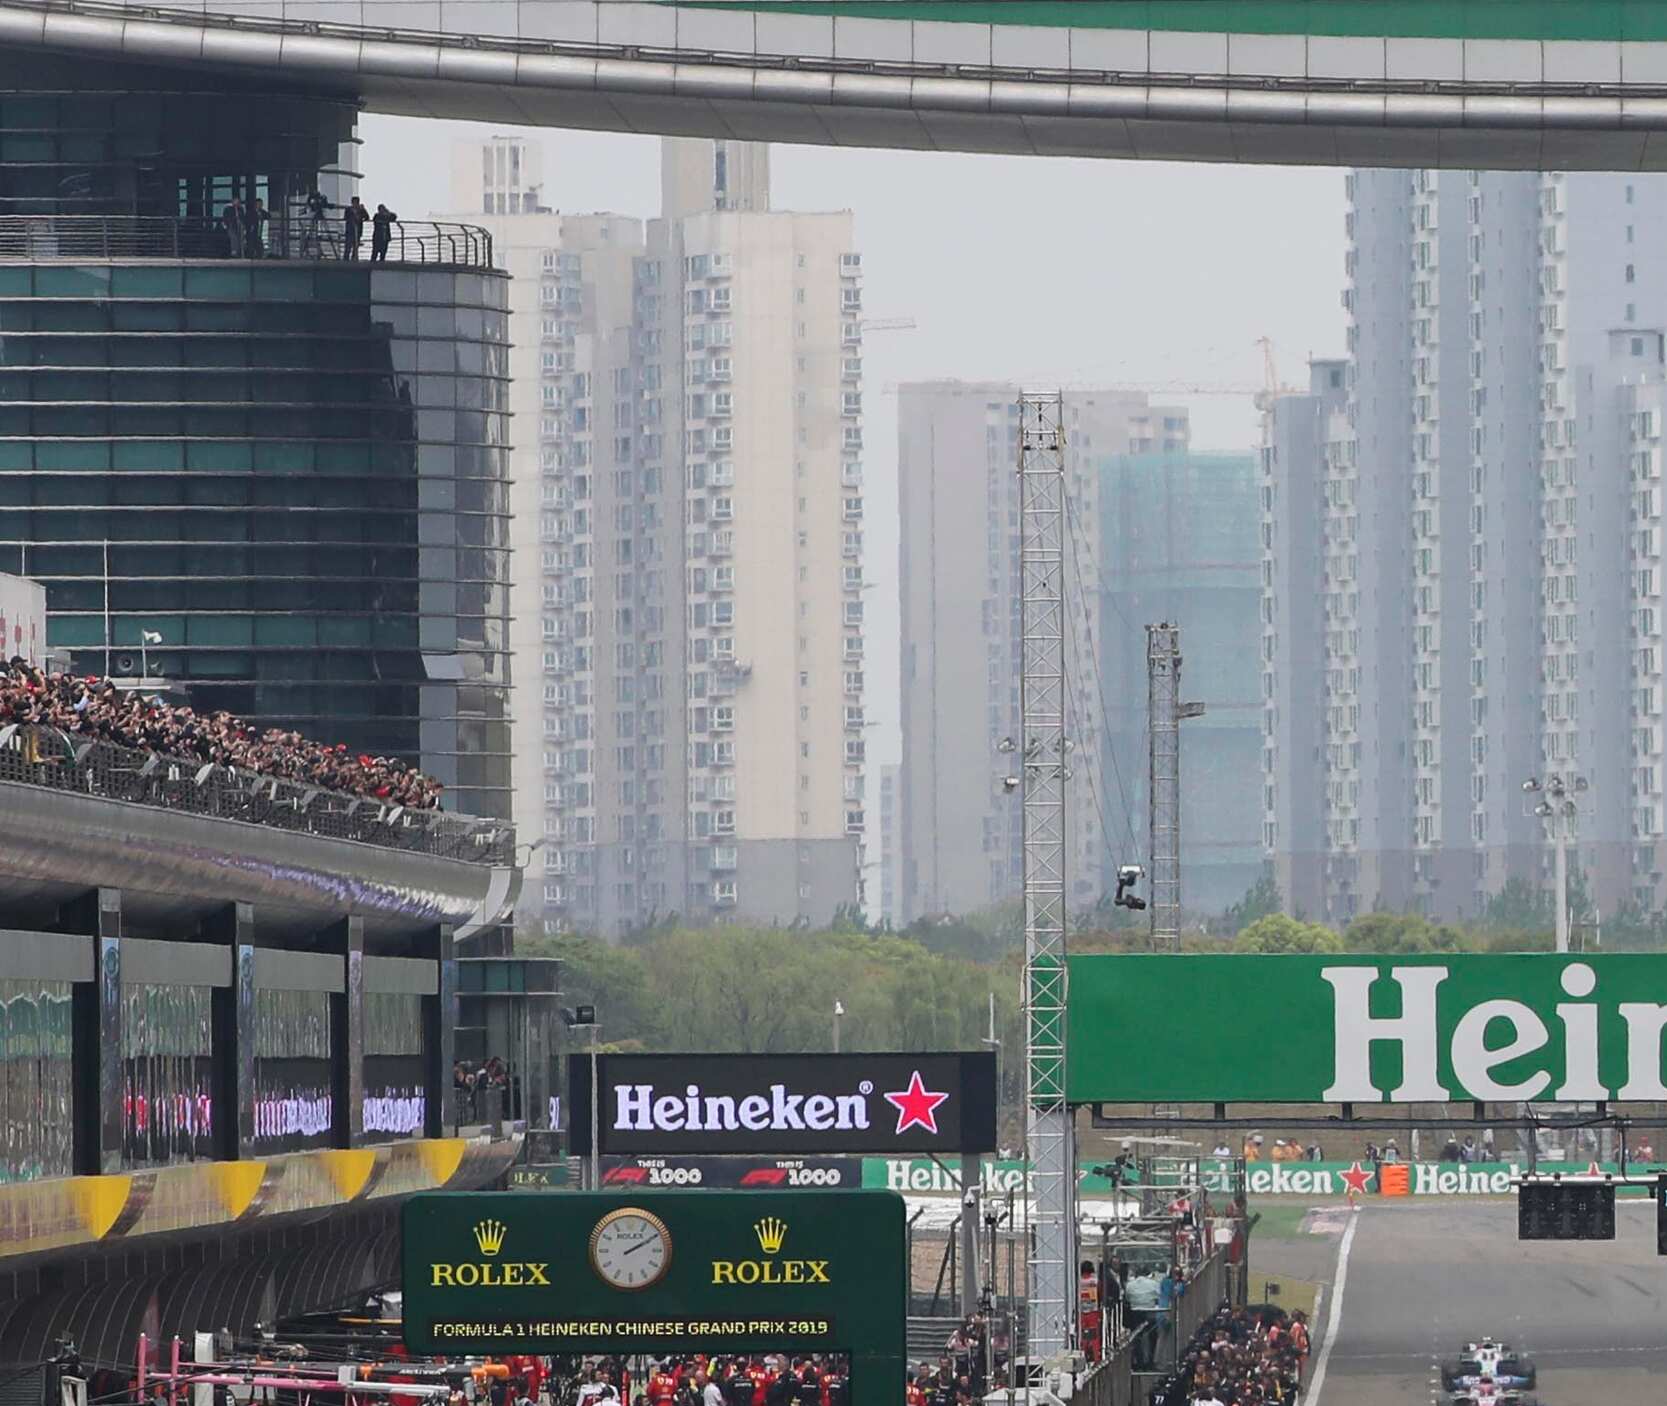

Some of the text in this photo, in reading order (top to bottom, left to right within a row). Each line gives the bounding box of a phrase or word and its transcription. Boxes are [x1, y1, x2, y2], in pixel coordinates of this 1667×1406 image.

[613, 1084, 870, 1131] Heineken
[649, 1167, 702, 1184] 1000
[788, 1168, 841, 1185] 1000
[431, 1263, 550, 1286] ROLEX
[712, 1260, 830, 1284] ROLEX
[434, 1321, 828, 1337] FORMULA 1 HEINEKEN CHINESE GRAND PRIX 2019
